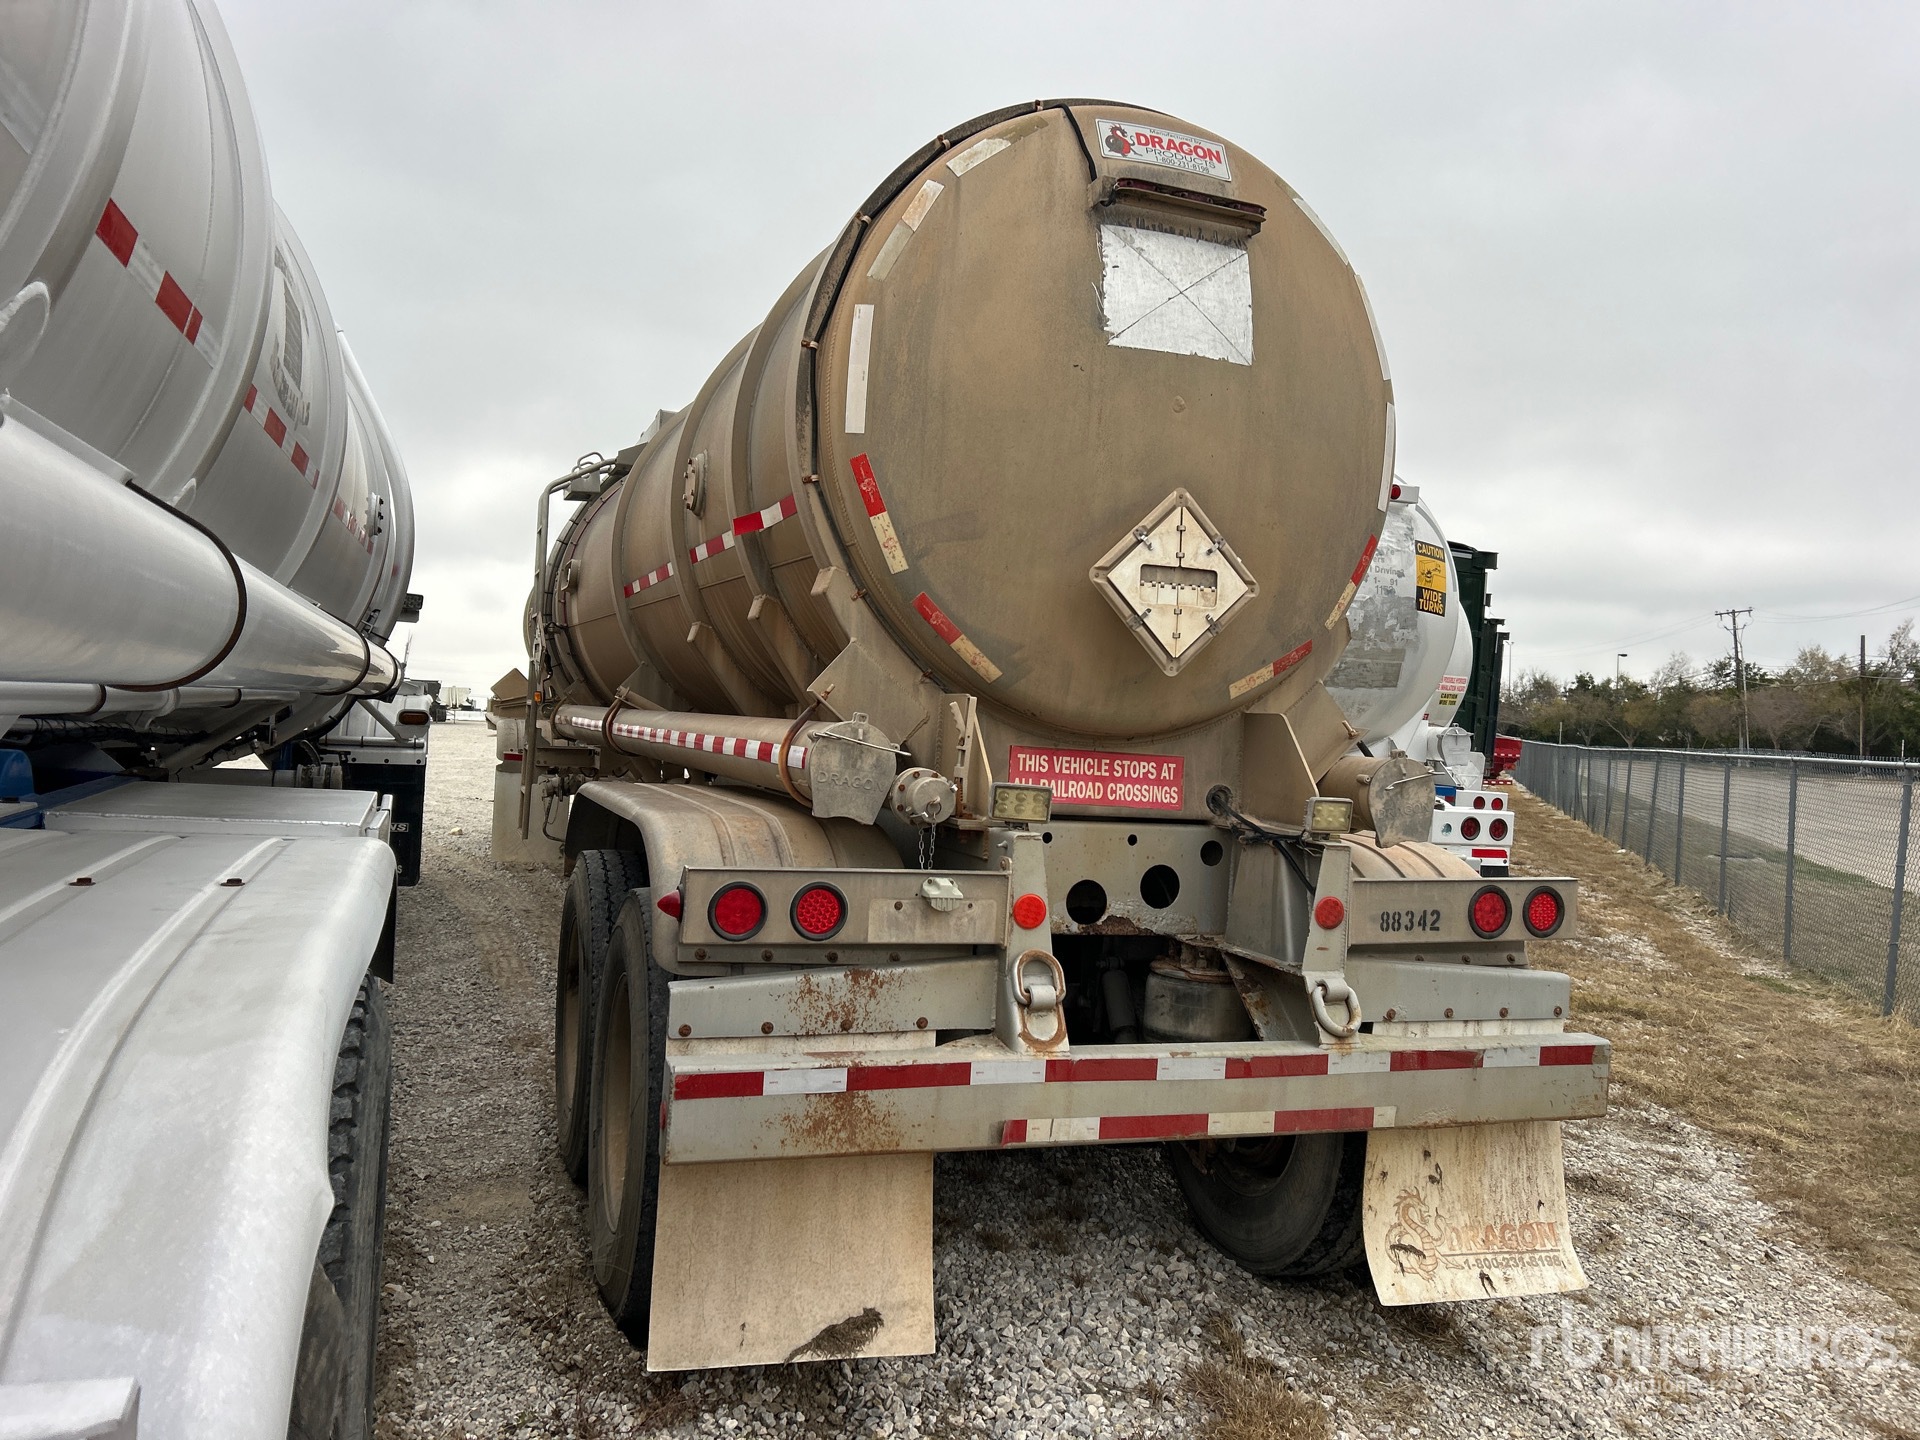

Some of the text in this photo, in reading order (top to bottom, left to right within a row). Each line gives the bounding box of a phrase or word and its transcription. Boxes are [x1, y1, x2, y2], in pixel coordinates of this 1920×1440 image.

[1135, 131, 1222, 164] DRAGON
[1145, 147, 1216, 169] PRODUCTS
[1416, 543, 1445, 560] CAUTION
[1419, 599, 1444, 615] TURNS
[1422, 588, 1442, 604] WIDE
[1017, 753, 1176, 781] THIS VEHICLE STOPS AT
[817, 770, 885, 792] DRAGON
[1107, 783, 1179, 804] CROSSINGS
[1380, 909, 1441, 932] 88342
[1446, 1221, 1558, 1252] DRAGON
